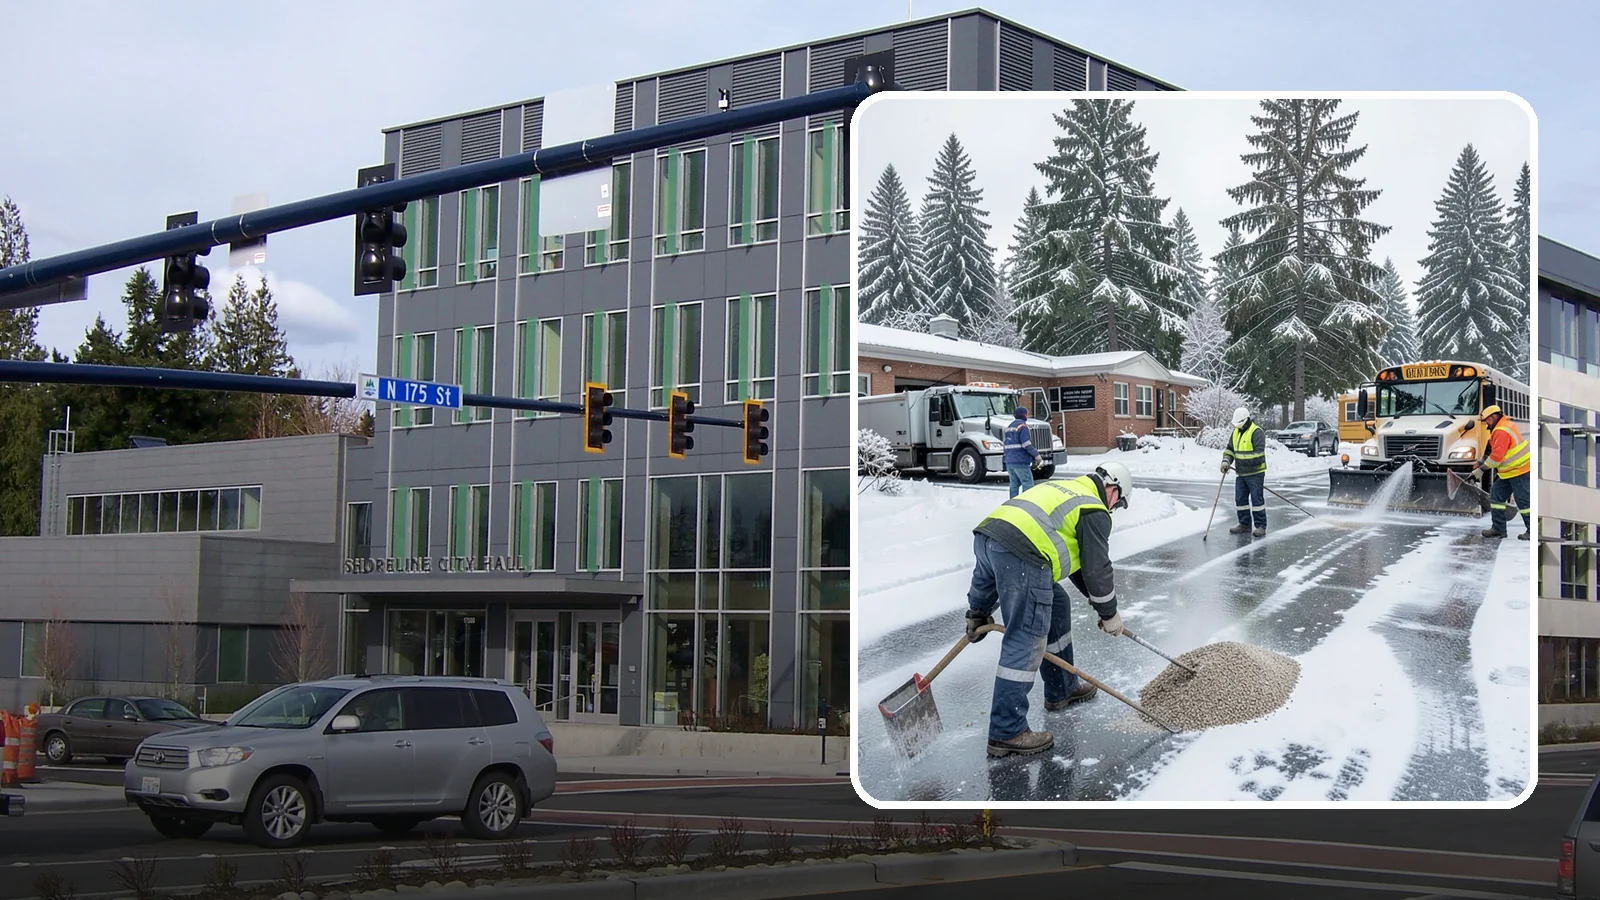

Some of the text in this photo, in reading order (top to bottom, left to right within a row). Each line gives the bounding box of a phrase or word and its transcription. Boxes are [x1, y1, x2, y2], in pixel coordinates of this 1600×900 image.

[387, 380, 451, 406] N 175 St
[344, 555, 525, 574] SHORELINE CITY HALL
